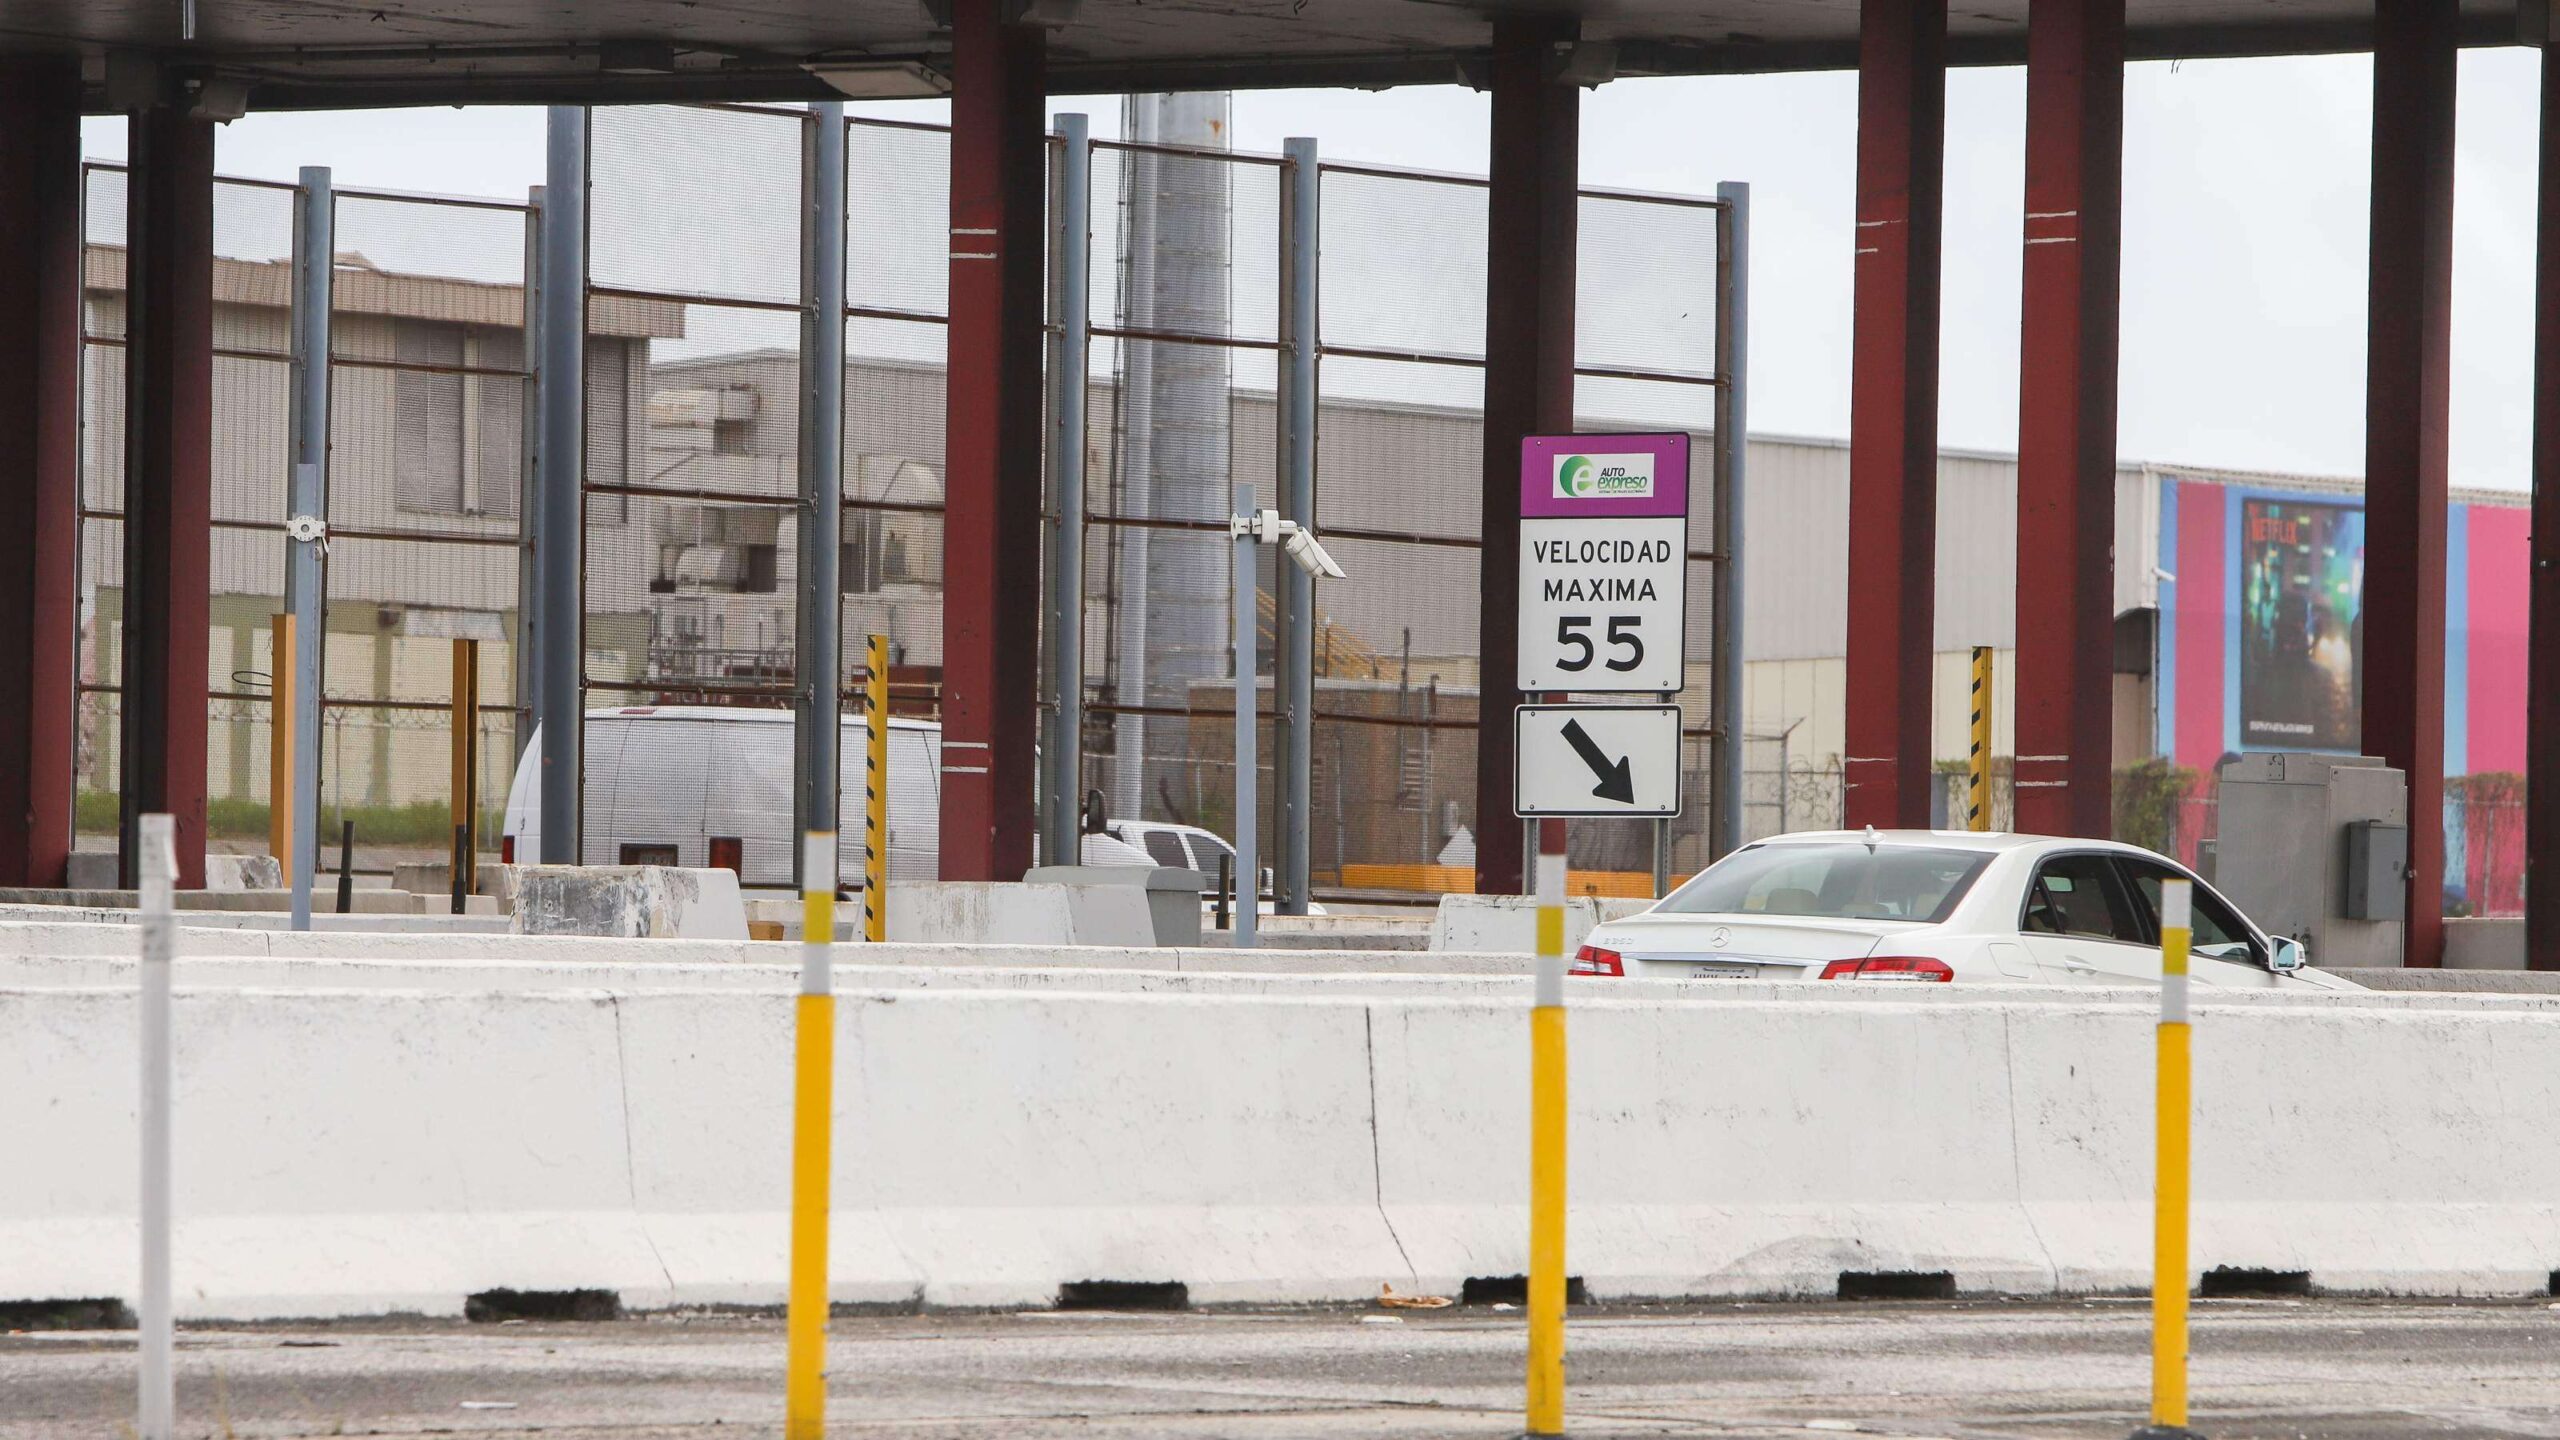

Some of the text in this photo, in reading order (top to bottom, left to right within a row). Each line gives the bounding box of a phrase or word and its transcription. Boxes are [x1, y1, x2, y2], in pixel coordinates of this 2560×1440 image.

[1597, 476, 1648, 491] expreso
[1600, 467, 1626, 477] AUTO
[2252, 517, 2297, 544] NETFLIX
[1533, 540, 1671, 564] VELOCIDAD
[1544, 578, 1657, 602] MAXIMA
[1555, 615, 1645, 672] 55
